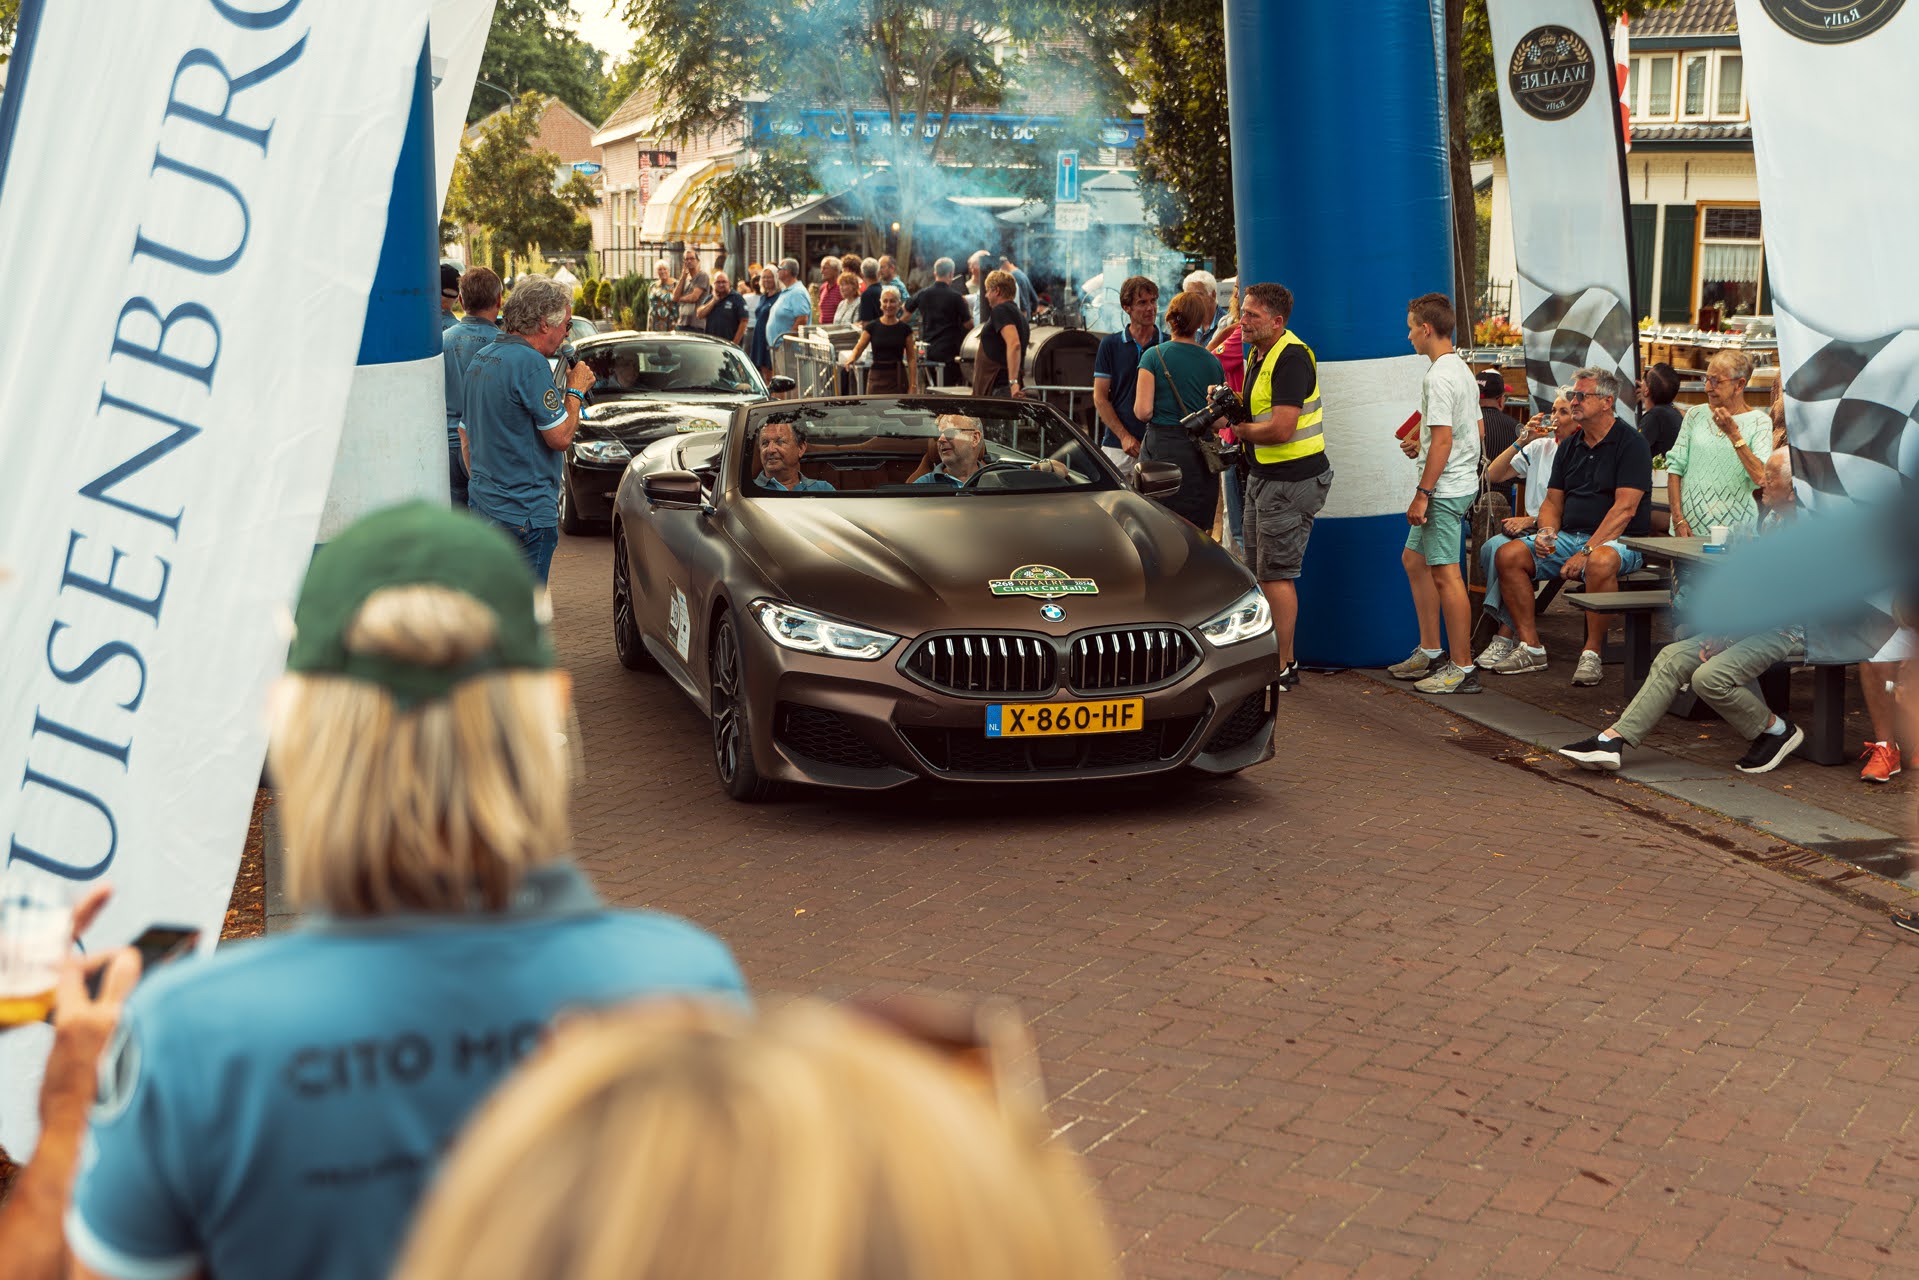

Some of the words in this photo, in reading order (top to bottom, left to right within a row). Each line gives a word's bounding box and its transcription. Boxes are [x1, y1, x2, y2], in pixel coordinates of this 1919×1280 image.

[8, 0, 310, 882] UISENBUR
[988, 723, 1000, 731] NL
[1009, 703, 1135, 732] X-860-HF
